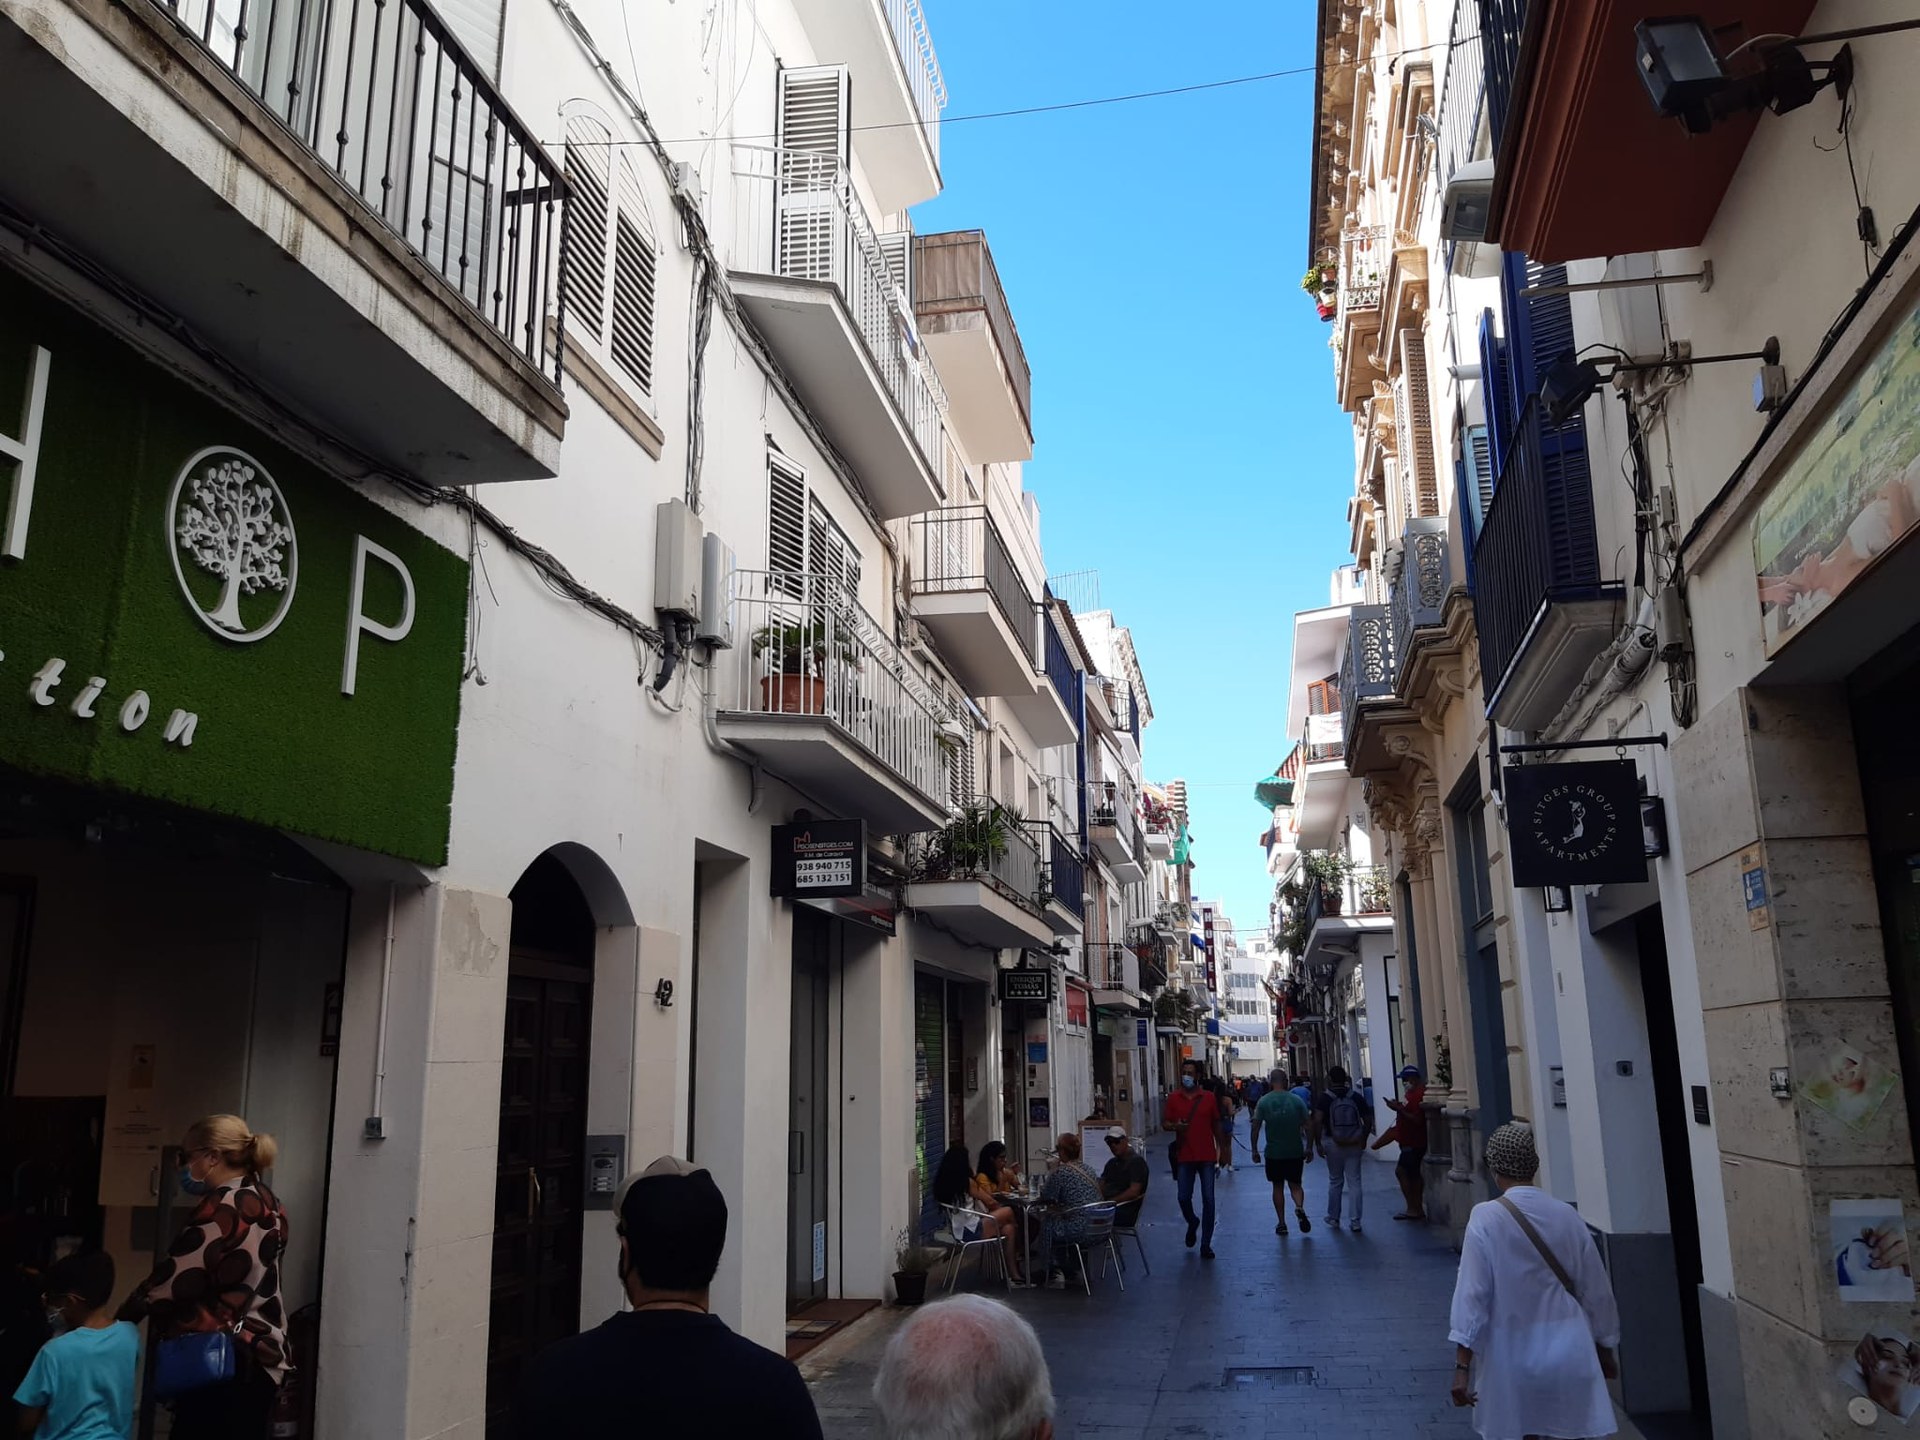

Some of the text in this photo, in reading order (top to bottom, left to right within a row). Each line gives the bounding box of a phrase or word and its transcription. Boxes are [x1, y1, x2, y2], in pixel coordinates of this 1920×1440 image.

[0, 649, 199, 748] tion
[1533, 785, 1616, 825] SITGES GROUP
[1534, 827, 1617, 862] APARTMENTS
[797, 861, 851, 871] 938 940 715
[797, 873, 850, 883] 685 132 151
[1204, 912, 1215, 988] HOTEL
